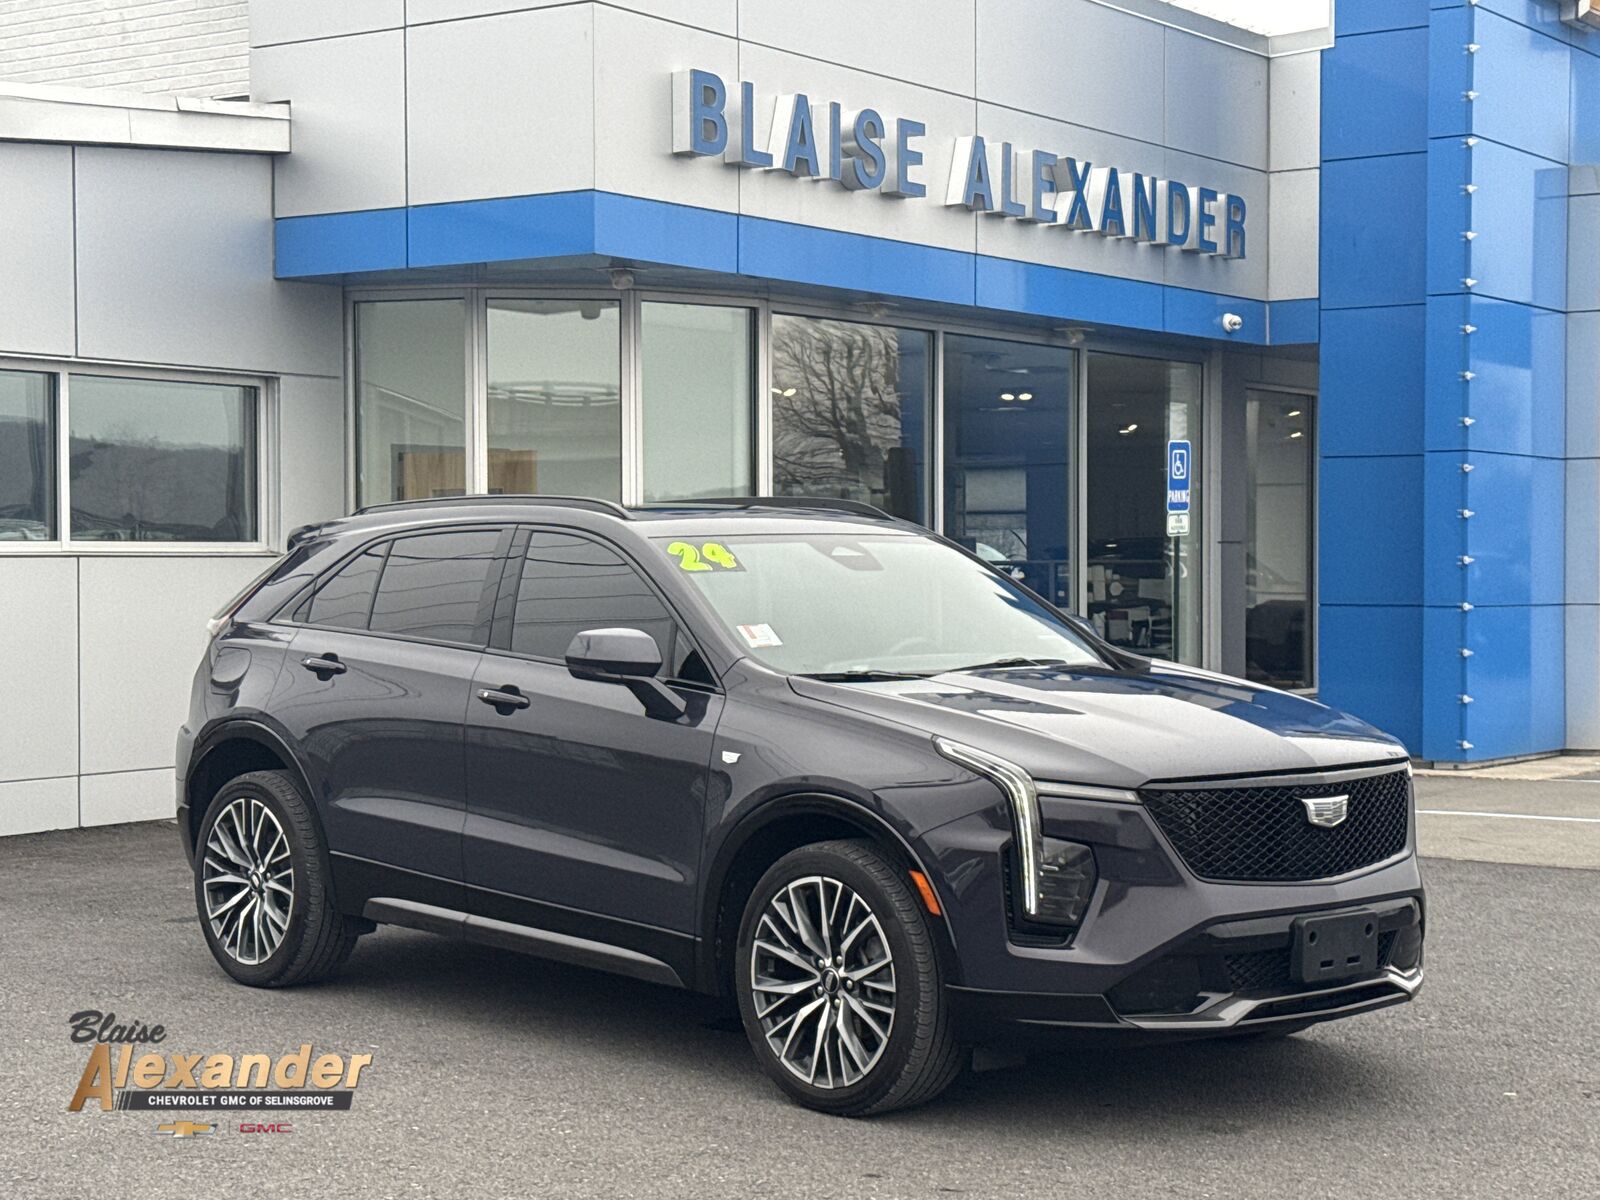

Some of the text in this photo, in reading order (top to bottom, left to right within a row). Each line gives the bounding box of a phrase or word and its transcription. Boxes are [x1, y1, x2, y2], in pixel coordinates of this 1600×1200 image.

[690, 68, 1246, 260] BLAISE ALEXANDER
[667, 541, 737, 571] 24
